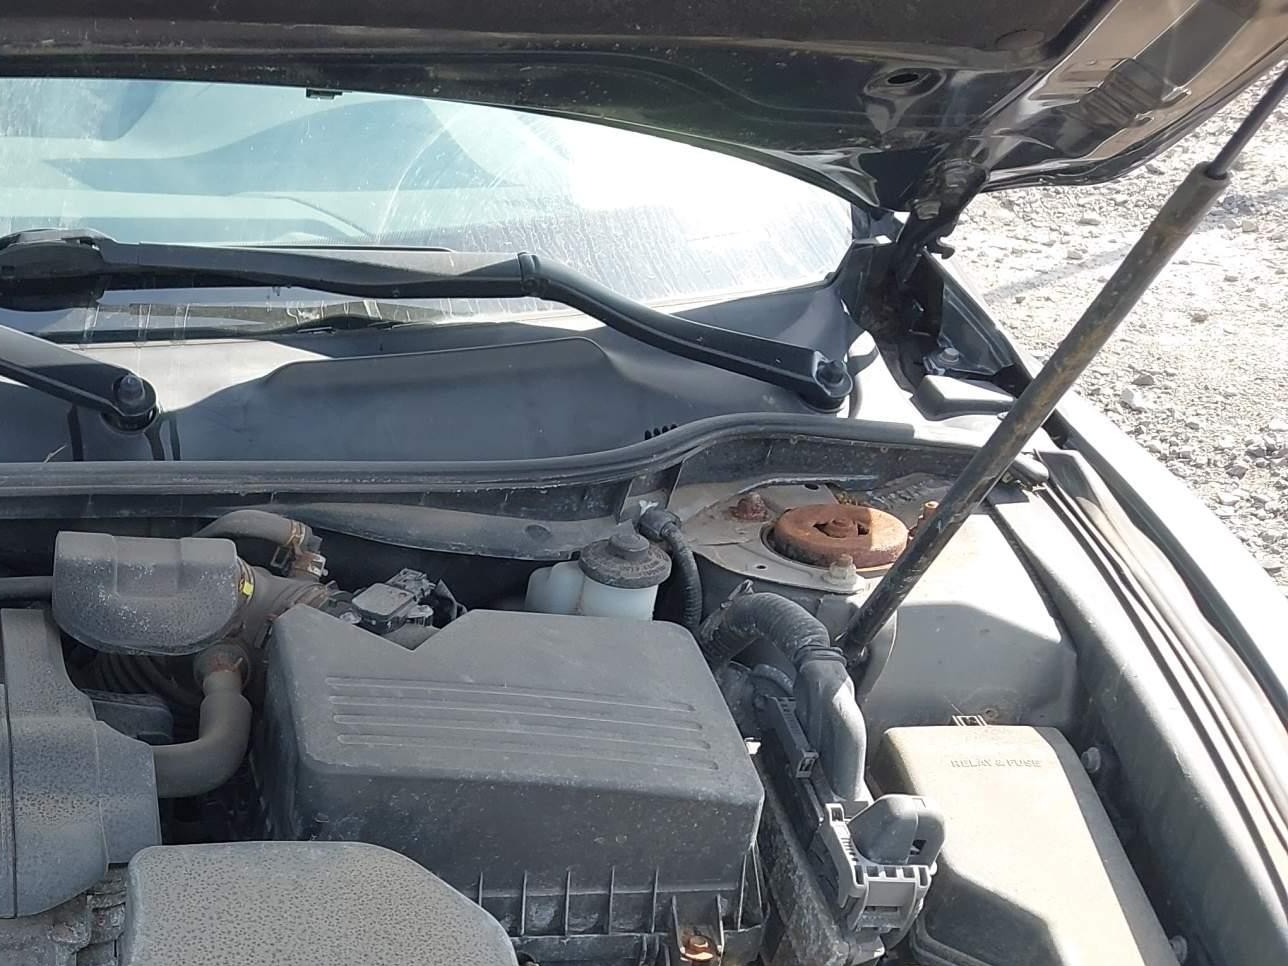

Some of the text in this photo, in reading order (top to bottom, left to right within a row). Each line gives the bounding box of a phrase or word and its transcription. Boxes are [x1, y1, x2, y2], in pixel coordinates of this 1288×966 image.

[950, 759, 1042, 768] RELAY & FUSE
